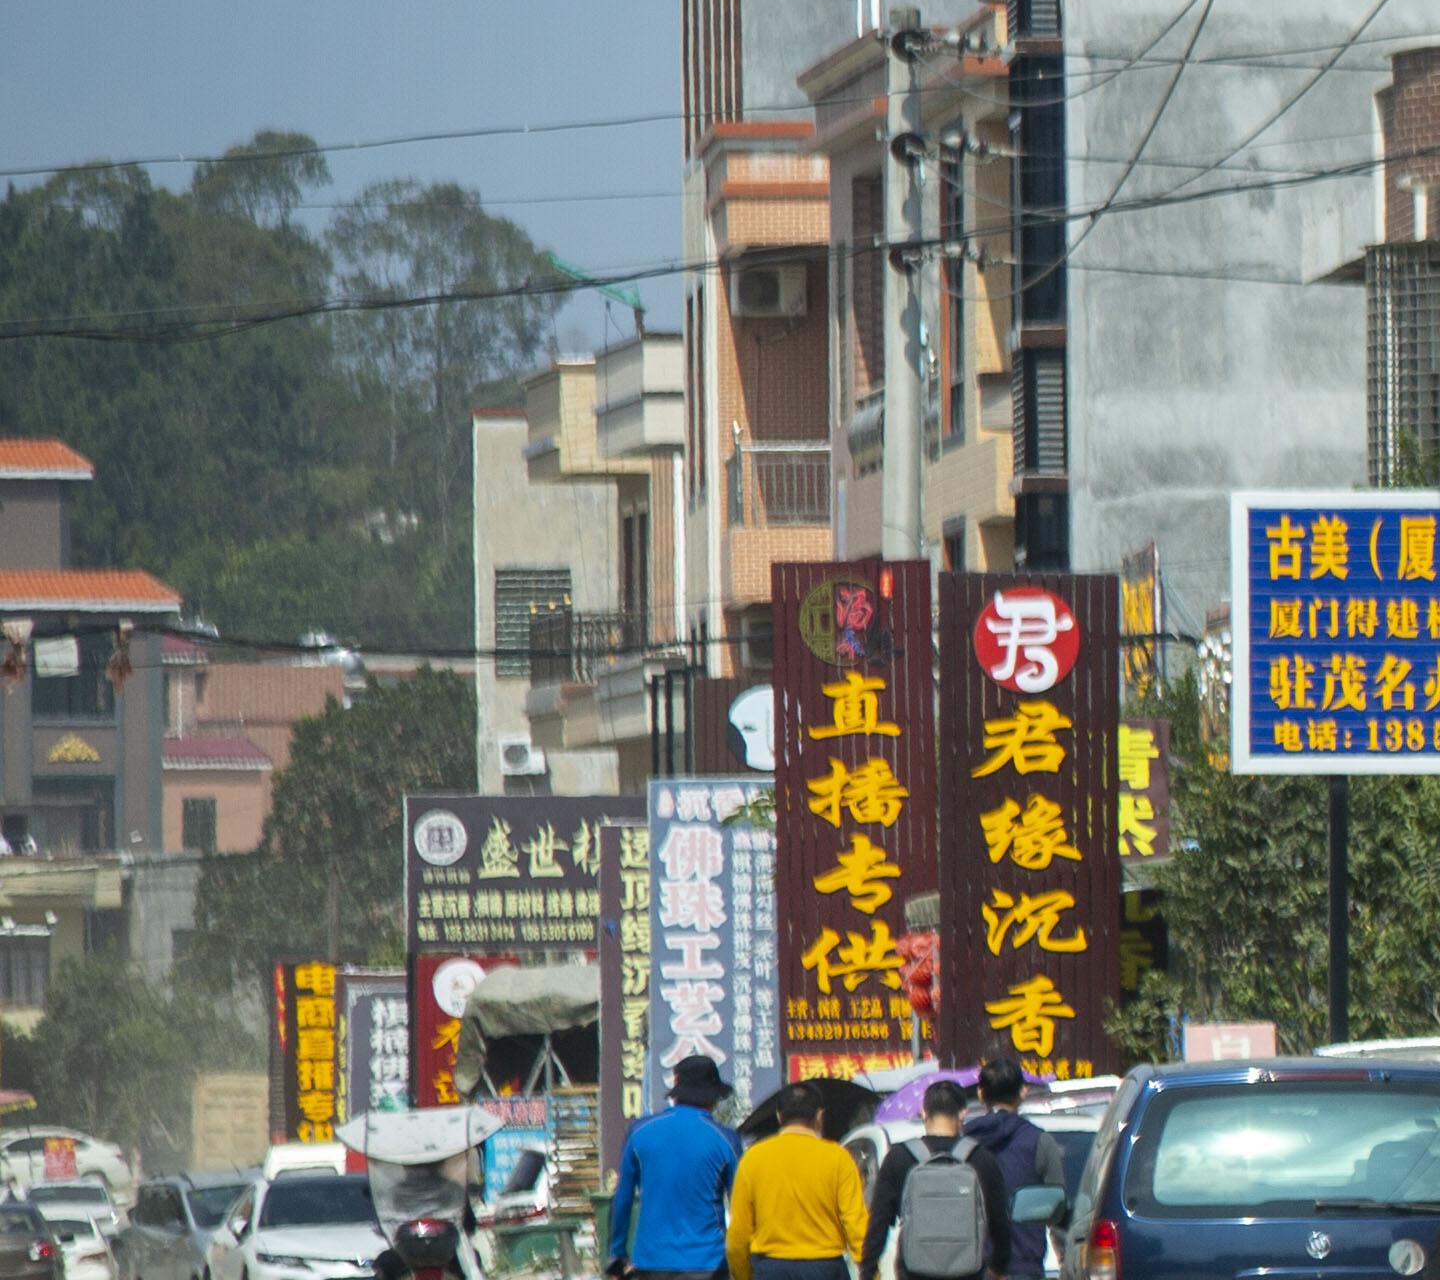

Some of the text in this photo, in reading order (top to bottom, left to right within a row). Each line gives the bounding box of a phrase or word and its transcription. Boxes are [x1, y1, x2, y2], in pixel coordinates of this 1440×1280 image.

[803, 672, 909, 993] 直播专供
[973, 701, 1087, 1057] 君缘沉香
